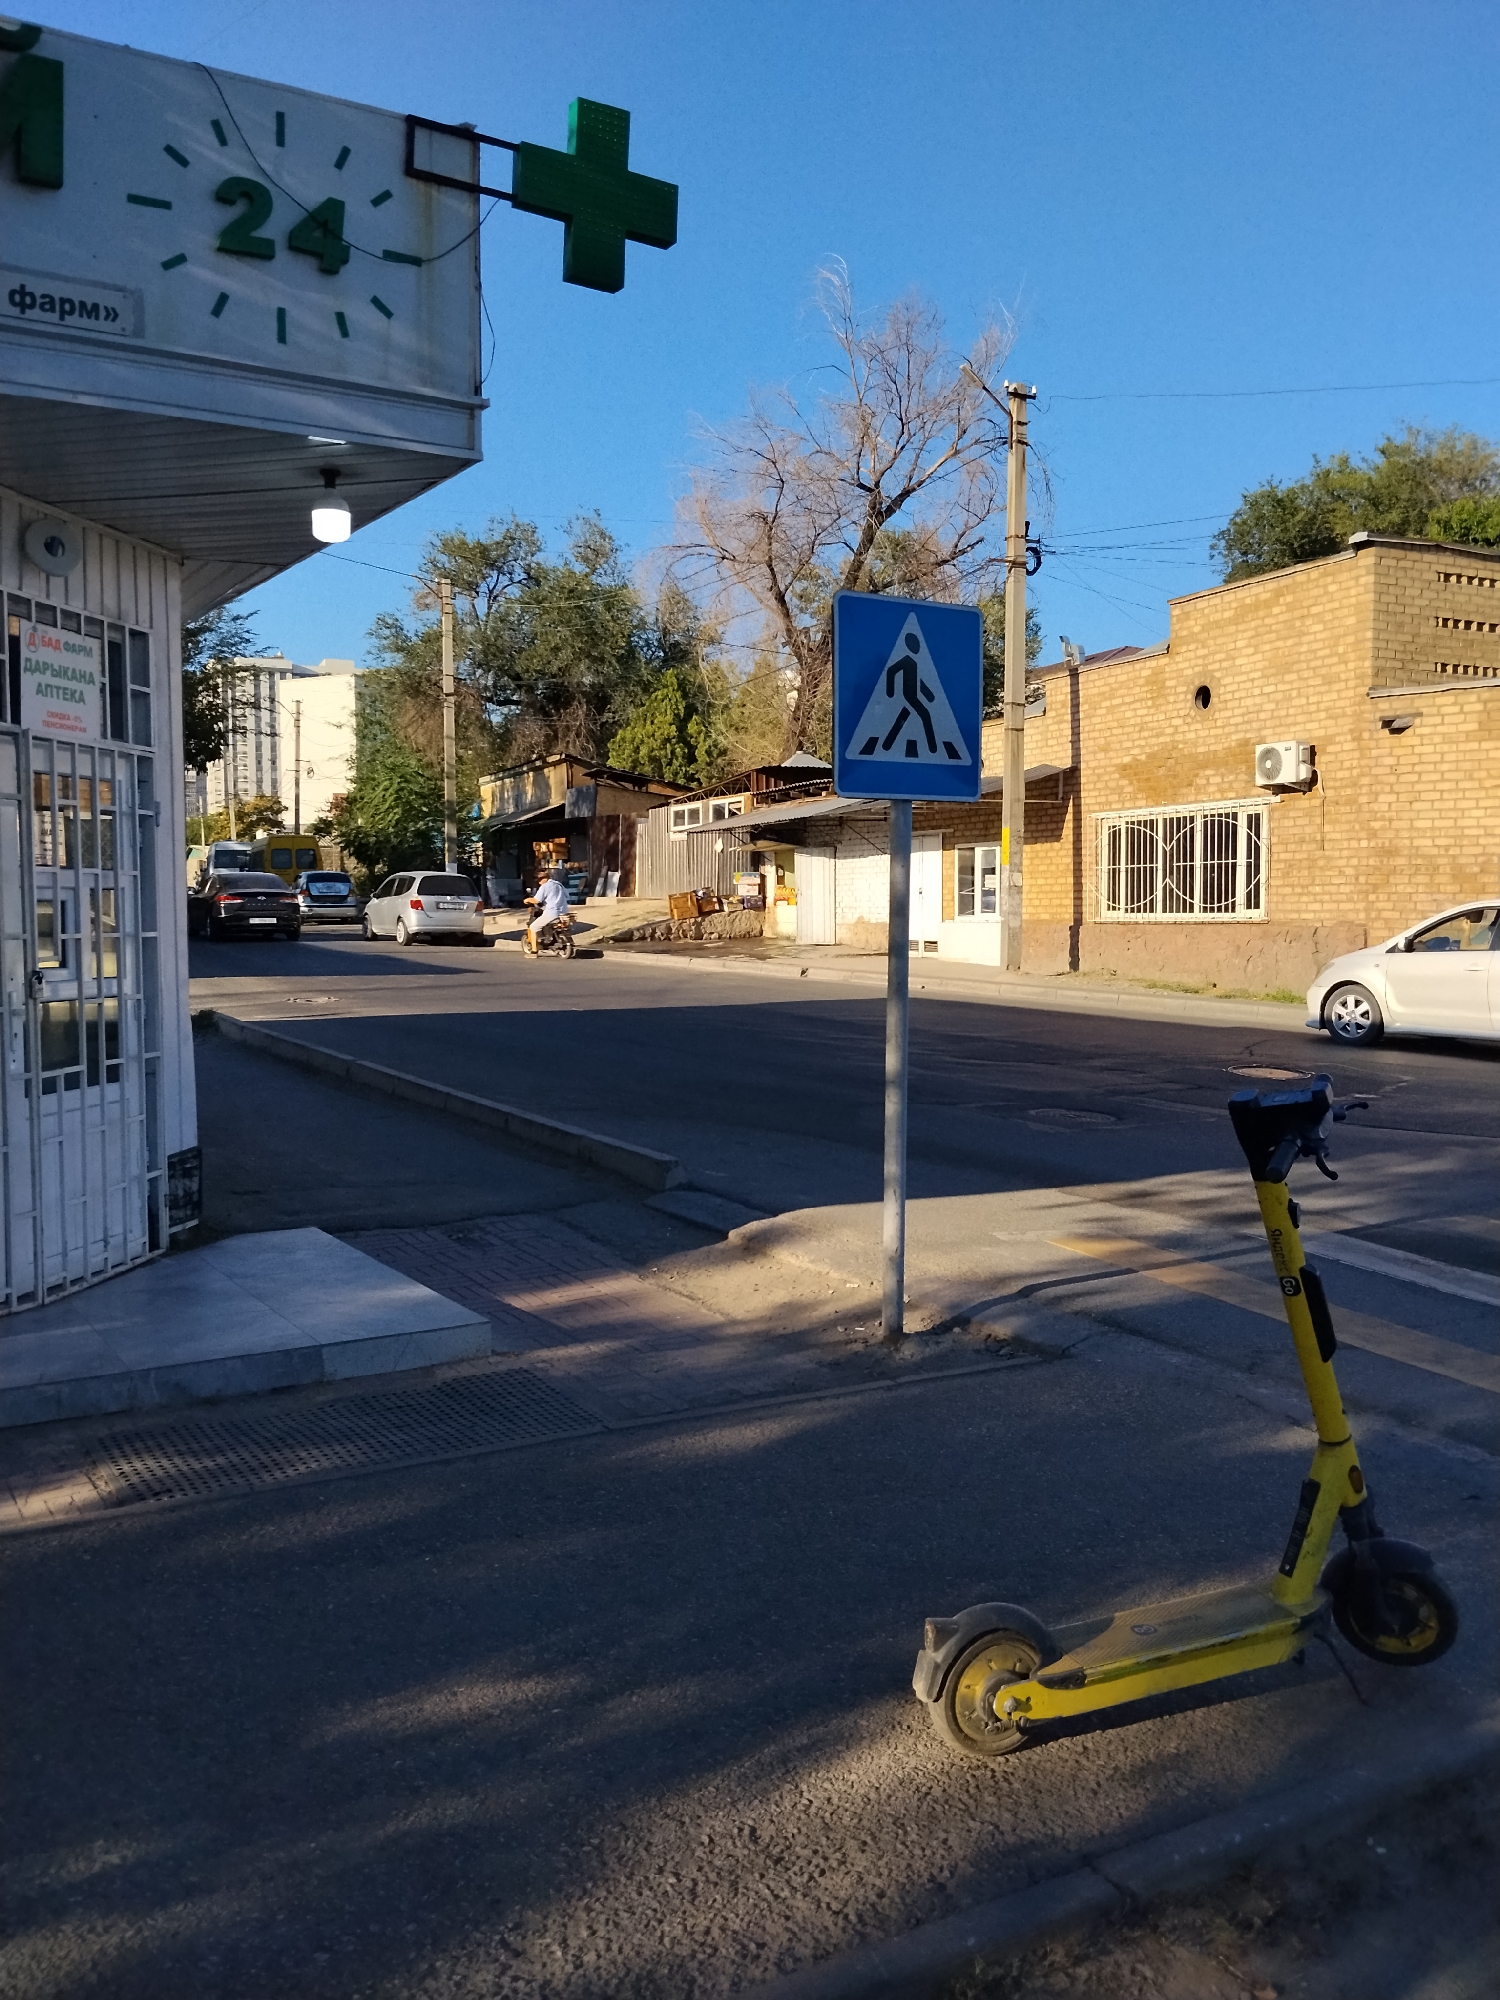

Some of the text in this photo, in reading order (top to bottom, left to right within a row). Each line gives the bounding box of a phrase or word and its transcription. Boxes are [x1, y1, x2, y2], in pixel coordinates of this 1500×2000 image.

[215, 176, 350, 275] 24
[8, 283, 119, 322] фарм»
[41, 635, 62, 653] БАД
[63, 640, 93, 658] ФАРМ
[23, 657, 96, 686] ДАРЫКАНА
[36, 682, 86, 705] АПТЕКА
[42, 720, 87, 733] ПЕНСИОНЕРАМ
[46, 710, 71, 721] СКИДКА
[1282, 1278, 1295, 1294] Go
